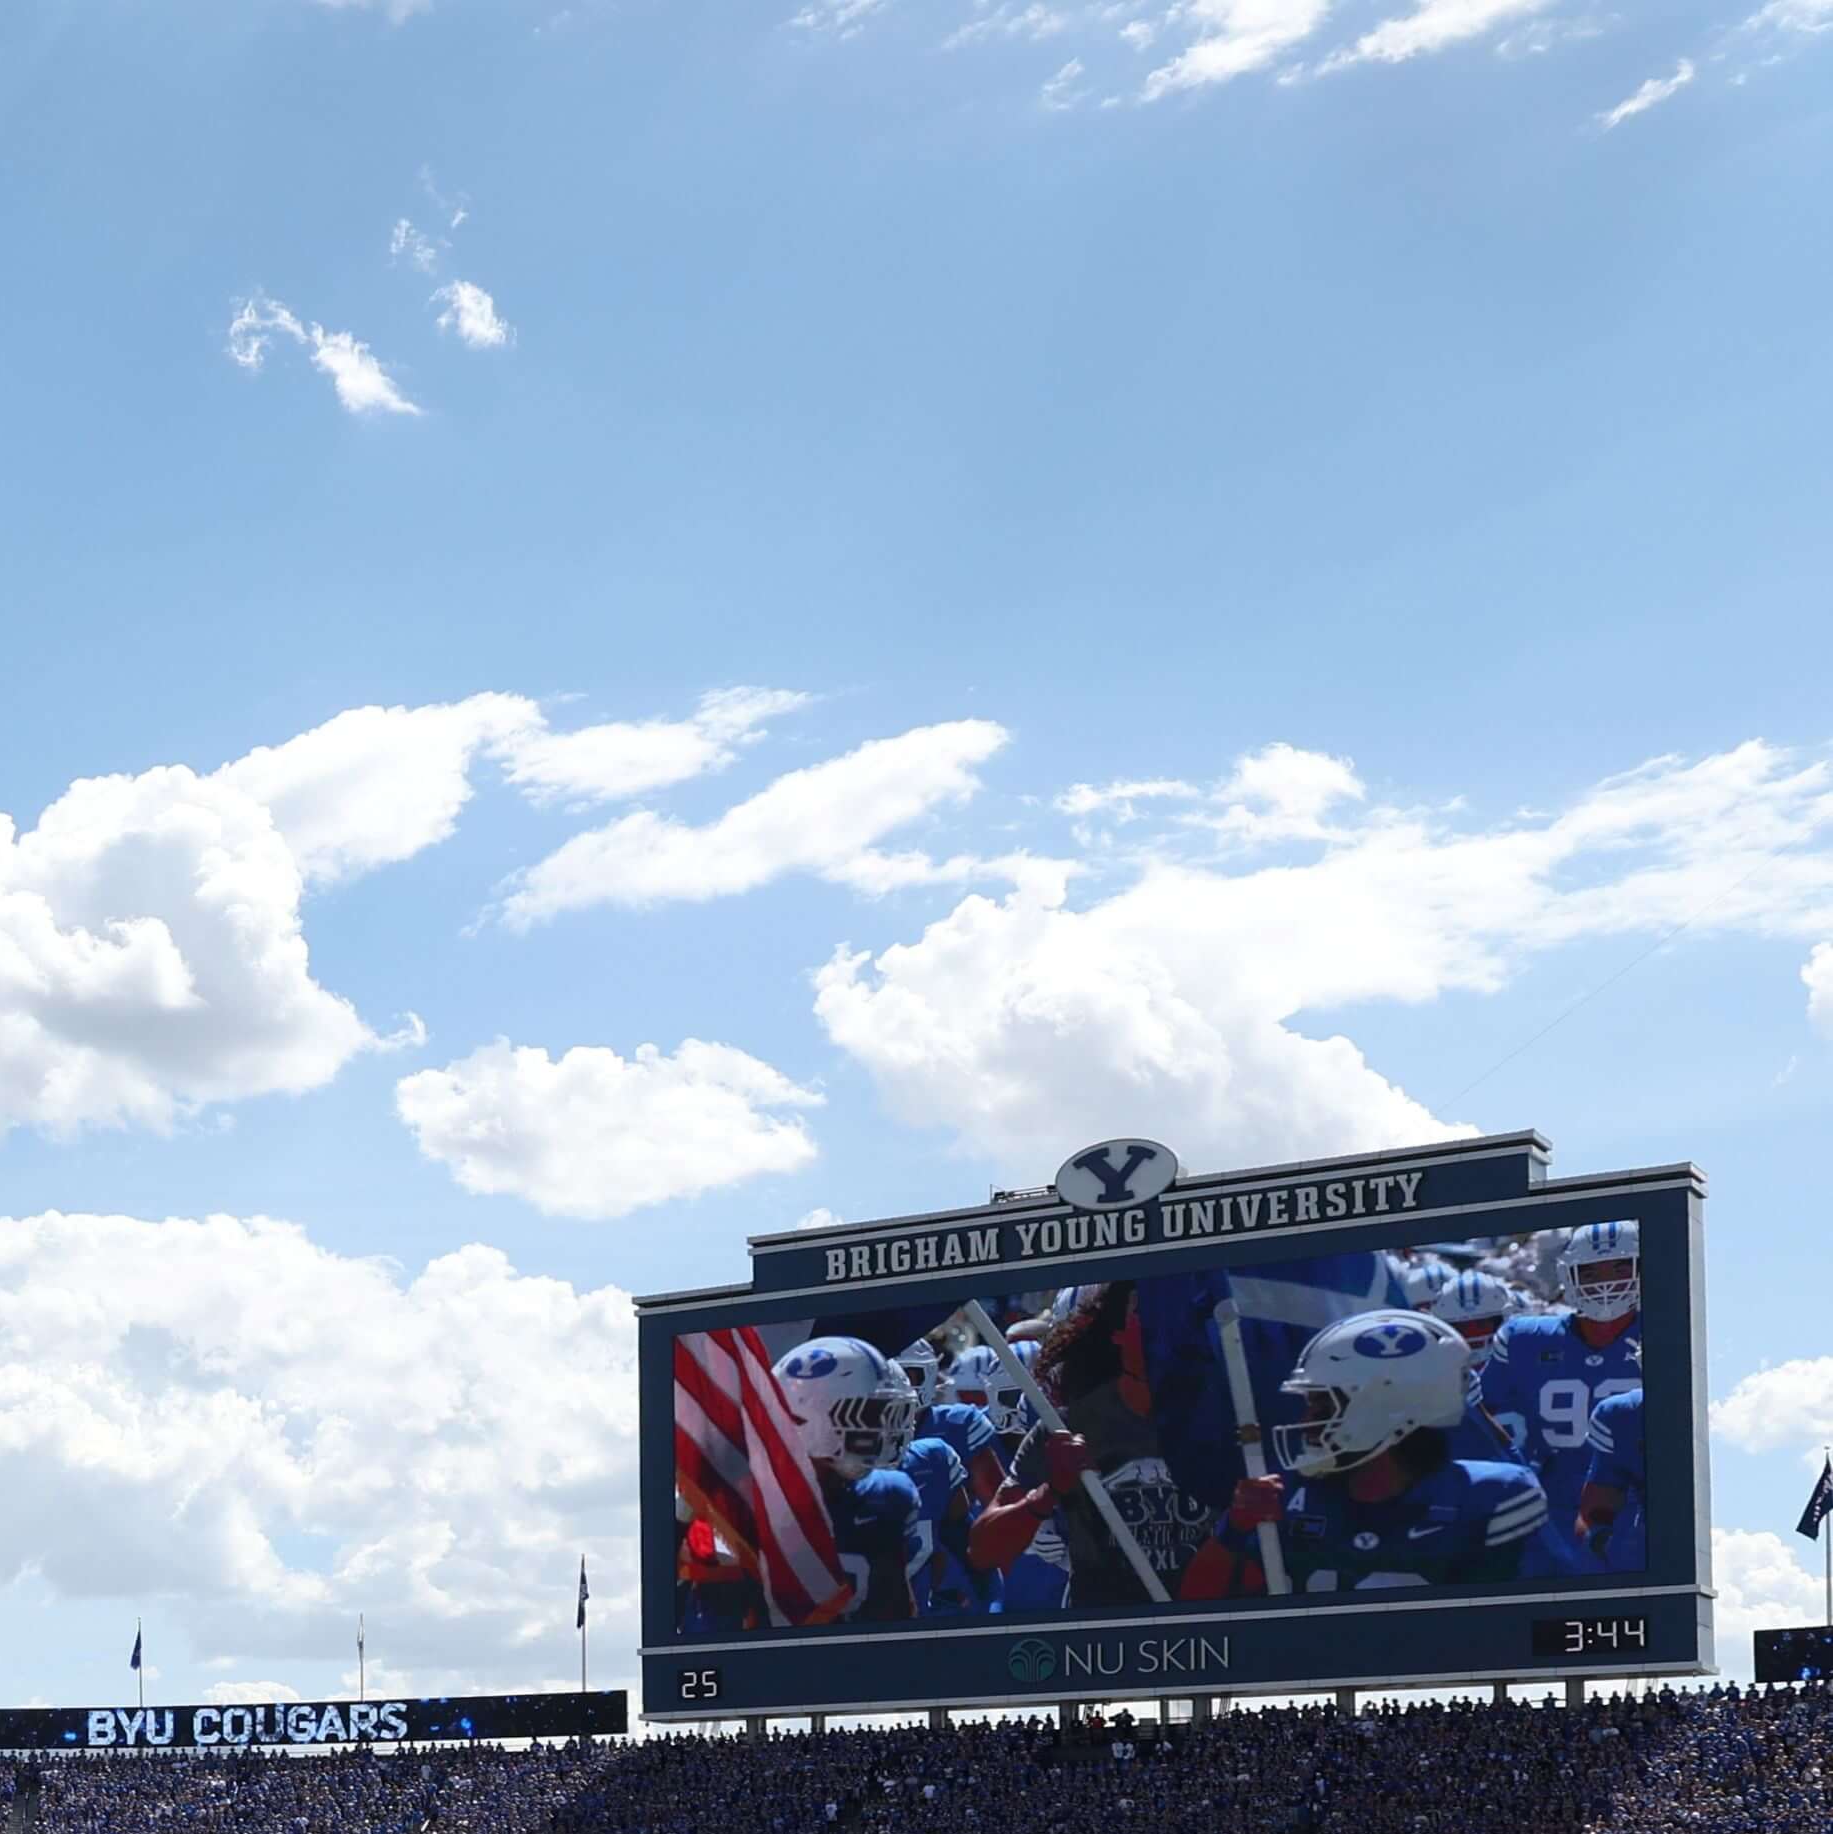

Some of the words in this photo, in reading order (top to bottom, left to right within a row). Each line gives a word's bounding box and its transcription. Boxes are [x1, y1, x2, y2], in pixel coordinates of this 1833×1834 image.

[826, 1227, 1000, 1282] BRIGHAM
[1014, 1209, 1145, 1257] YOUNG
[1162, 1171, 1423, 1239] UNIVERSITY
[1065, 1641, 1124, 1676] NU
[1136, 1636, 1228, 1673] SKIN
[1565, 1620, 1643, 1652] 3:44
[682, 1670, 718, 1698] 25
[88, 1709, 174, 1746] BYU
[193, 1703, 408, 1744] COUGARS
